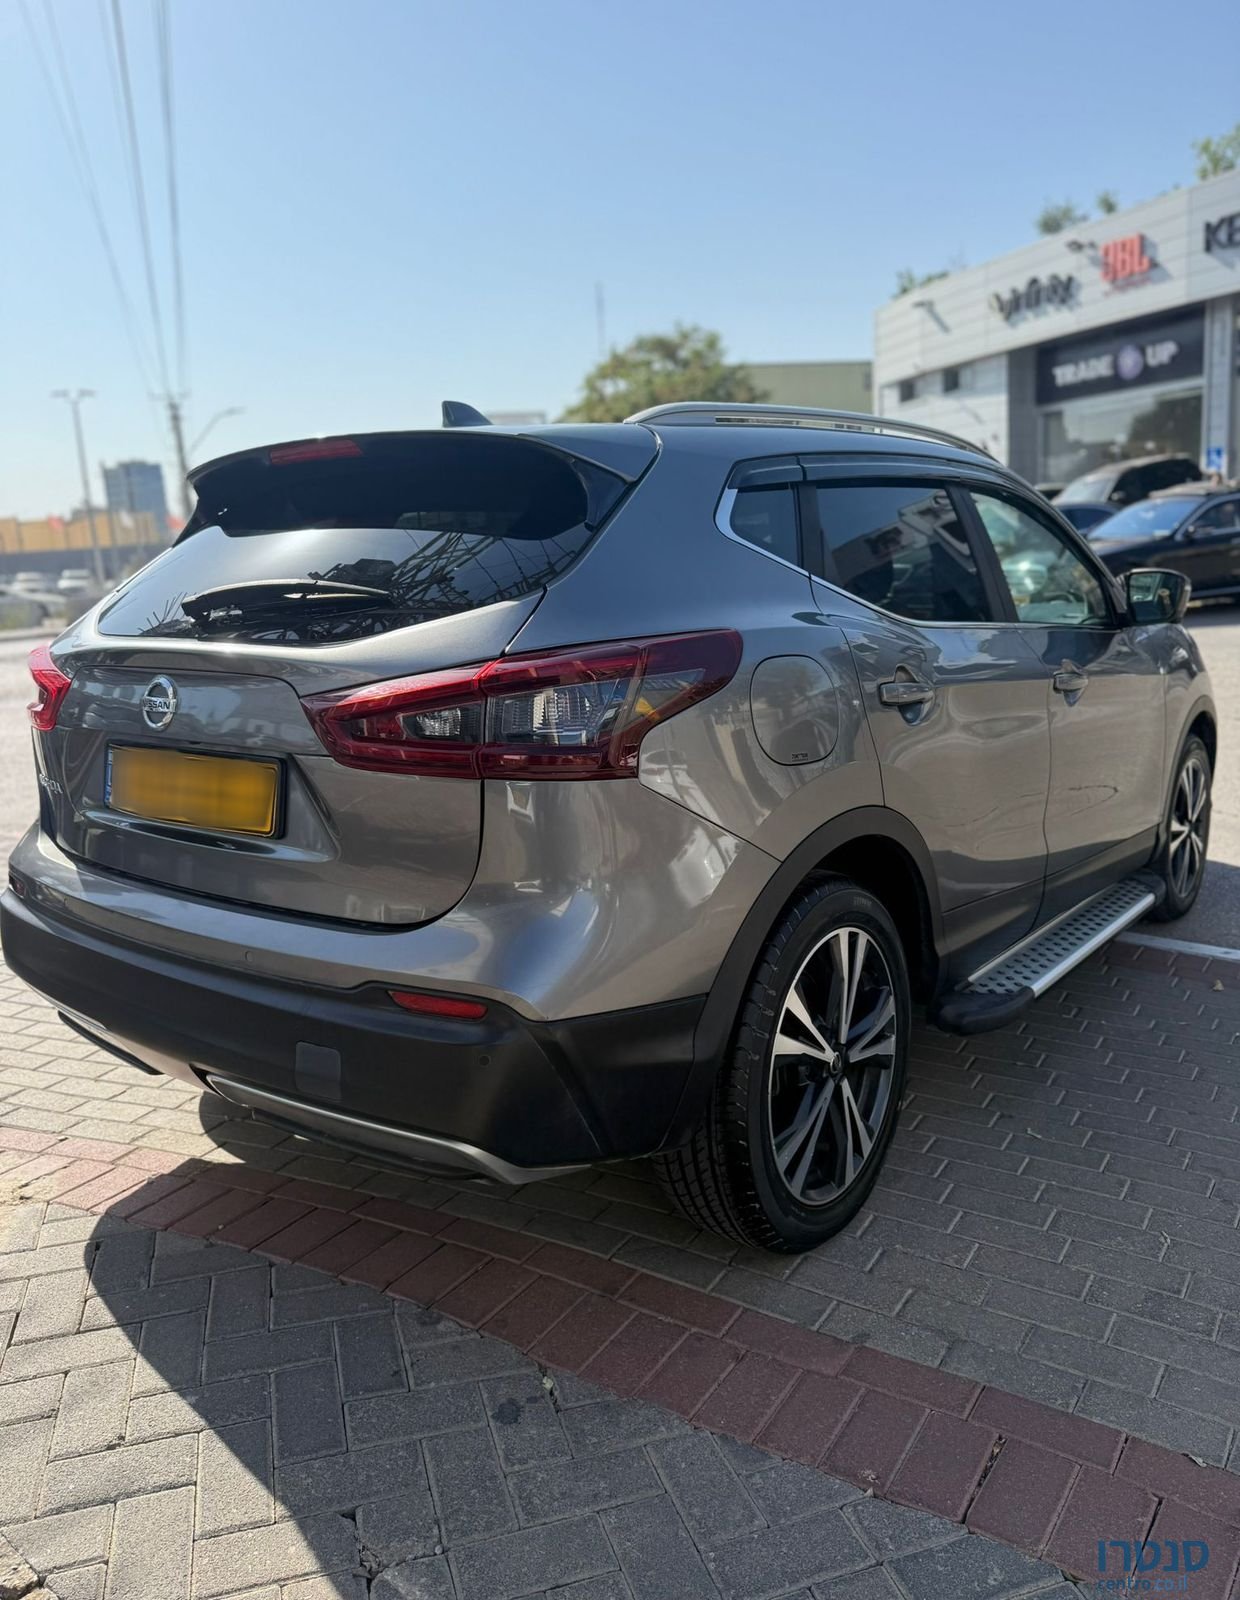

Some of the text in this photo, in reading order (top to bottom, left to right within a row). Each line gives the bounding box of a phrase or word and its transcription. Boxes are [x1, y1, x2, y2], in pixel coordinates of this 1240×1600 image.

[1100, 232, 1150, 282] JBL
[1052, 340, 1178, 387] TRADE UP
